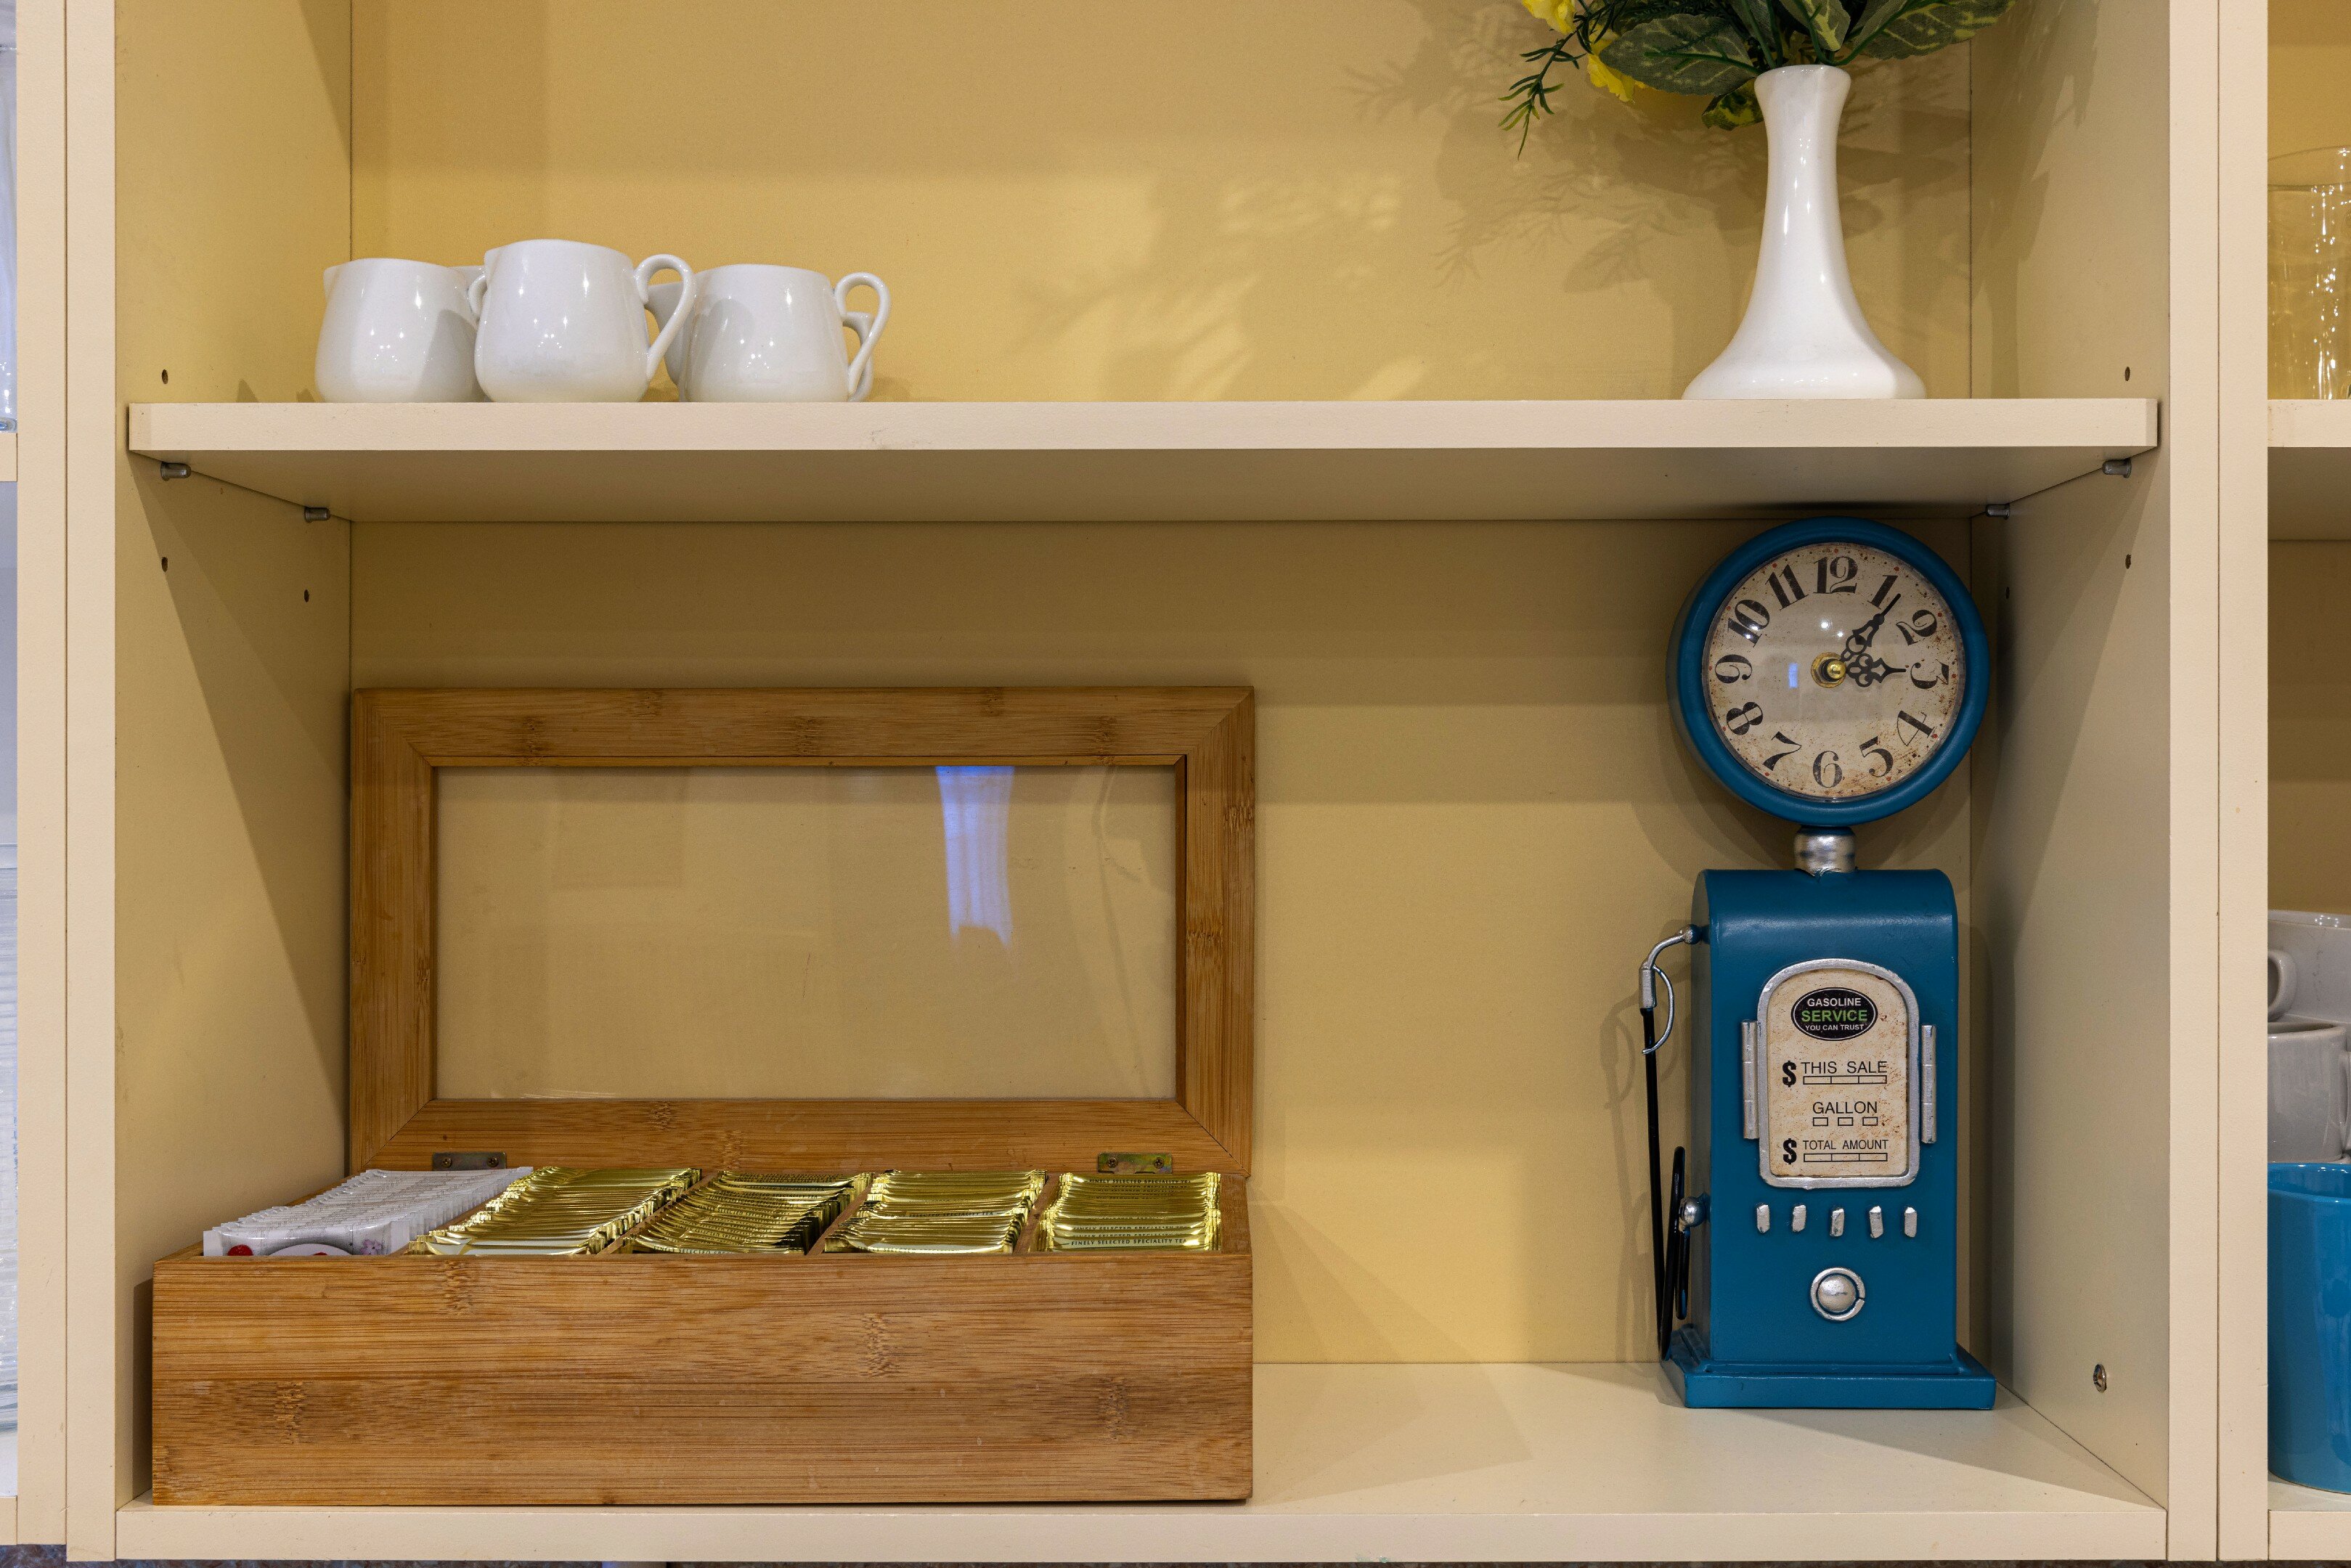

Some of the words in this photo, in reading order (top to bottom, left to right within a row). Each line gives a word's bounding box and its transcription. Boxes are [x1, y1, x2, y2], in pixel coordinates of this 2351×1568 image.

[1765, 565, 1809, 611] 11
[1813, 556, 1859, 595] 12
[1867, 575, 1898, 610] 1
[1728, 599, 1770, 648] 10
[1896, 610, 1937, 646] 2
[1714, 654, 1752, 684] 9
[1910, 662, 1949, 690] 3
[1726, 701, 1764, 736] 8
[1896, 710, 1936, 746] 4
[1762, 732, 1802, 771] 7
[1859, 736, 1894, 777] 5
[1812, 751, 1843, 788] 6
[1801, 1010, 1867, 1022] SERVICE
[1806, 997, 1861, 1007] GASOLINE
[1782, 1061, 1797, 1087] $
[1801, 1061, 1837, 1074] THIS
[1846, 1061, 1888, 1074] SALE
[1812, 1101, 1878, 1114] GALLON
[1782, 1138, 1797, 1164] $
[1803, 1140, 1836, 1151] TOTAL
[1842, 1139, 1888, 1150] AMOUNT
